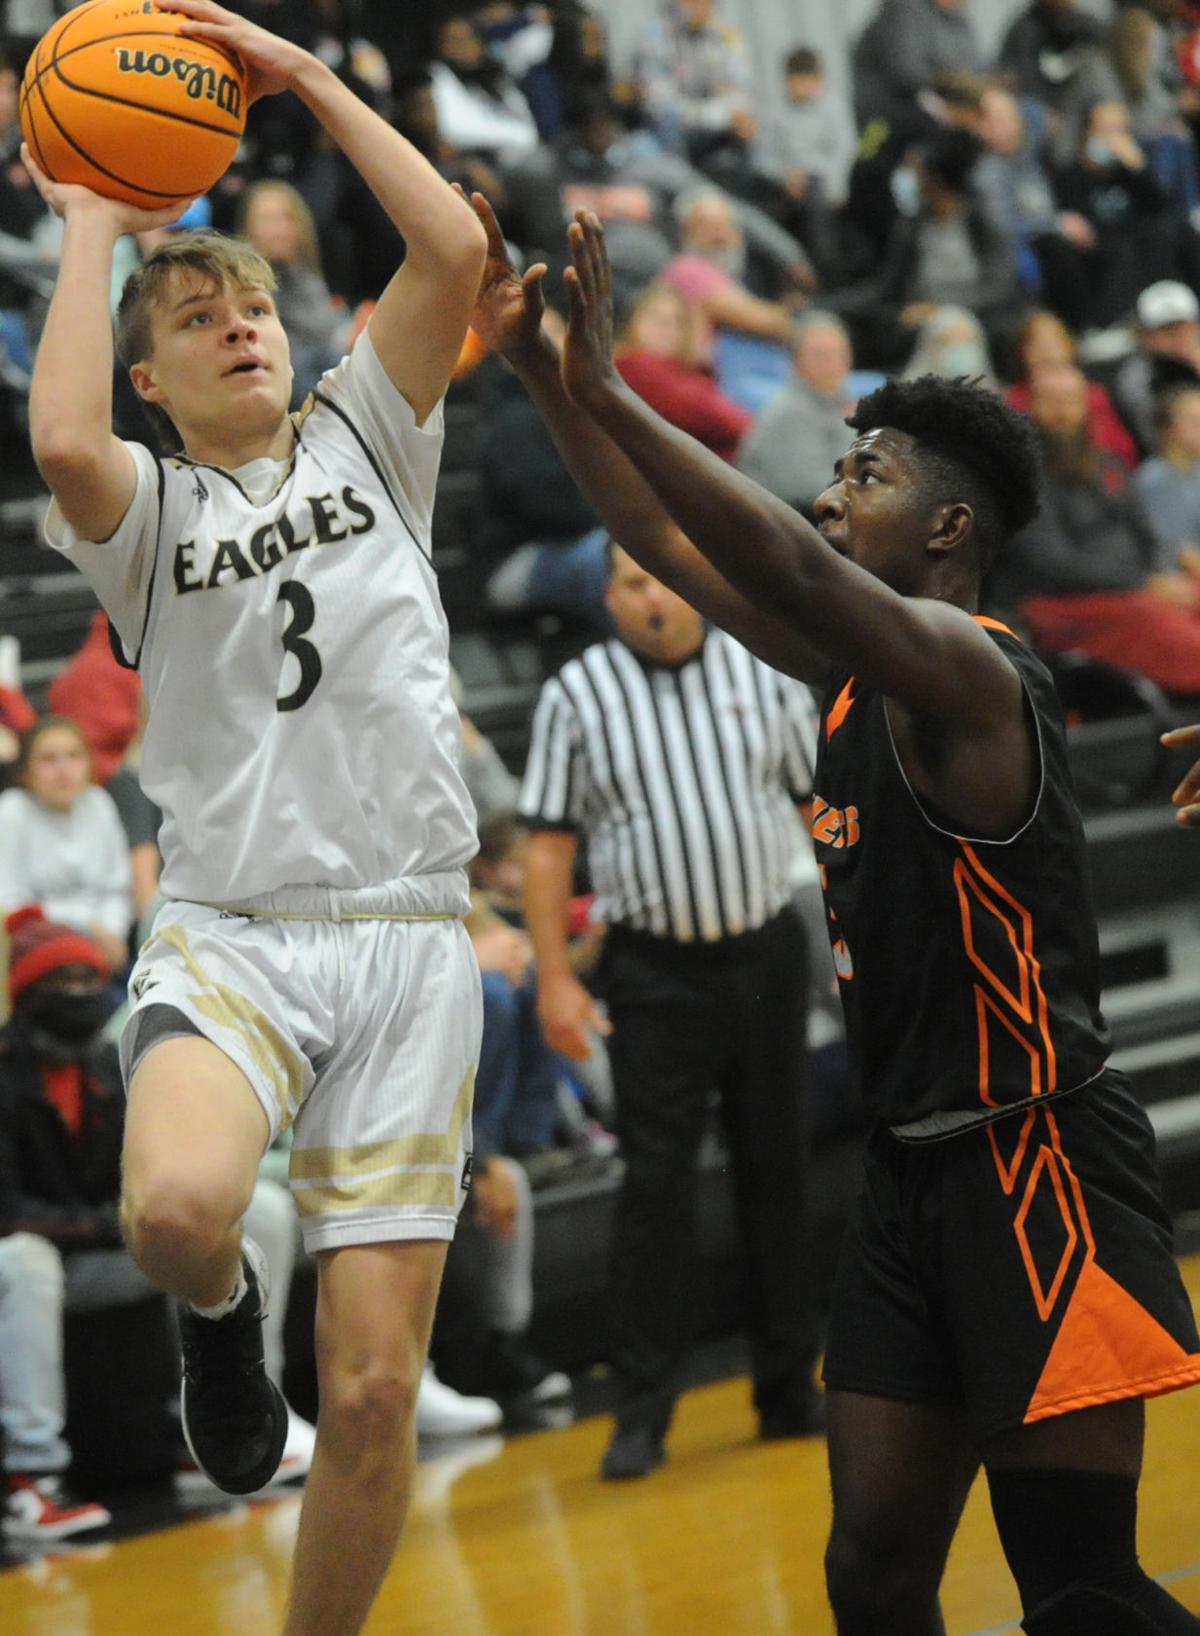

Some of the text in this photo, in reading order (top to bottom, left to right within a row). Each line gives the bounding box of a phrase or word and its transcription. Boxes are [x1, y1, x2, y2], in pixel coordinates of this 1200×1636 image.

[117, 48, 242, 119] Wilson
[174, 486, 375, 595] EAGLES
[276, 580, 322, 712] 3
